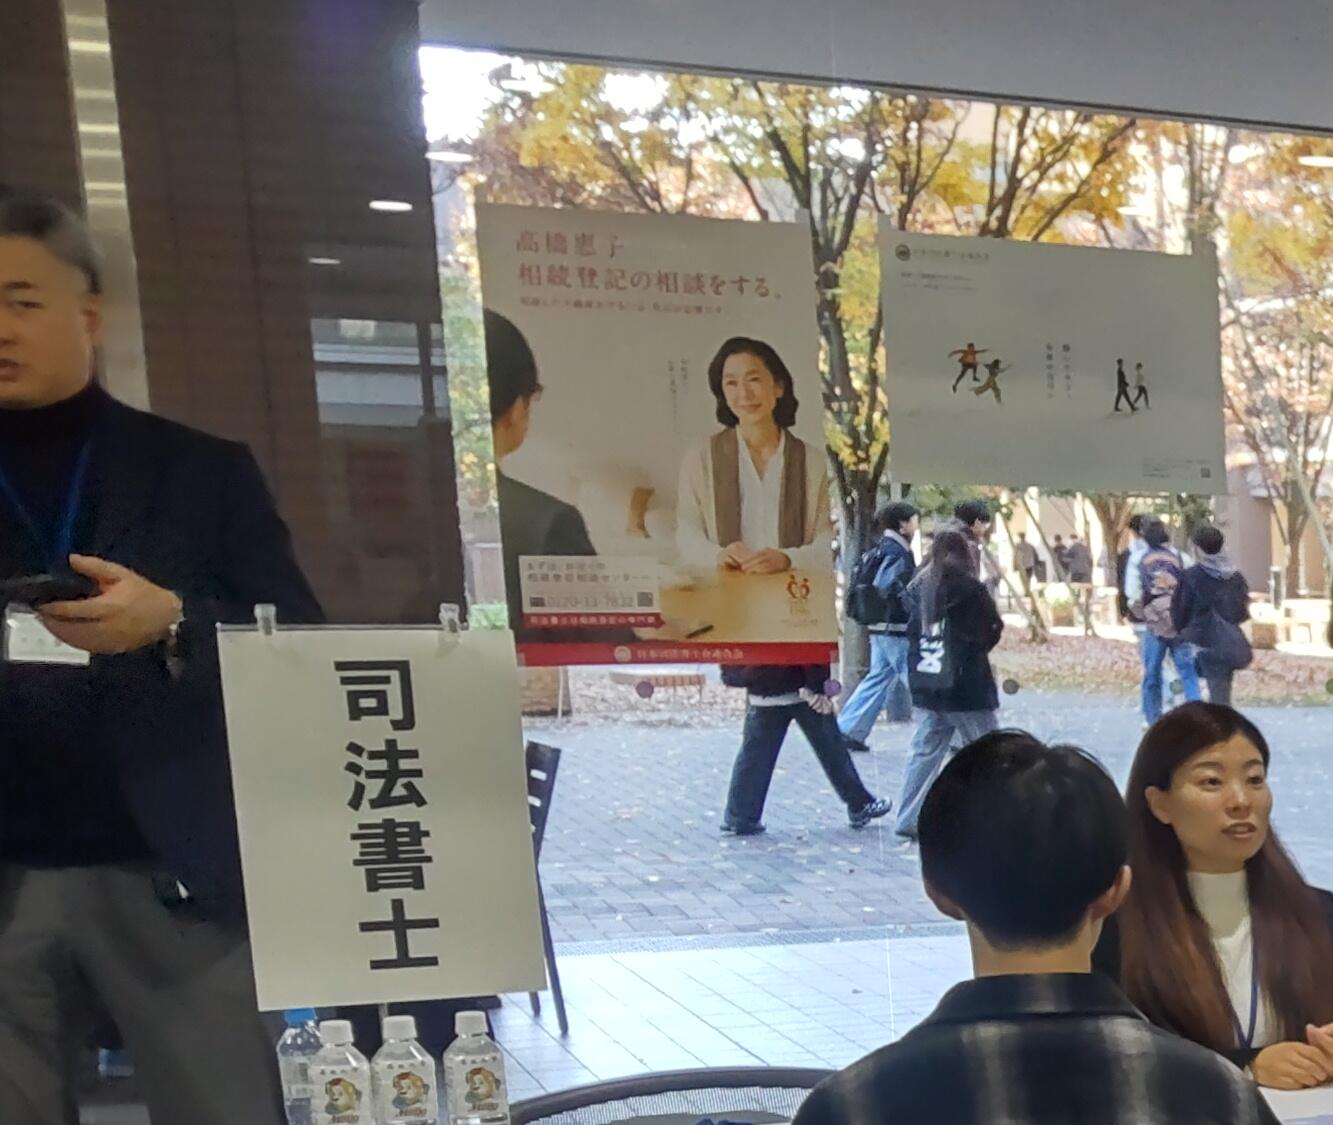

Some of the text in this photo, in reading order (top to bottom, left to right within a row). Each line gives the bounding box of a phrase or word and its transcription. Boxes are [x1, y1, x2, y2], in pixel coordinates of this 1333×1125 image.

[519, 263, 782, 300] 相続登記の相談をする。
[333, 659, 440, 970] 司法書士
